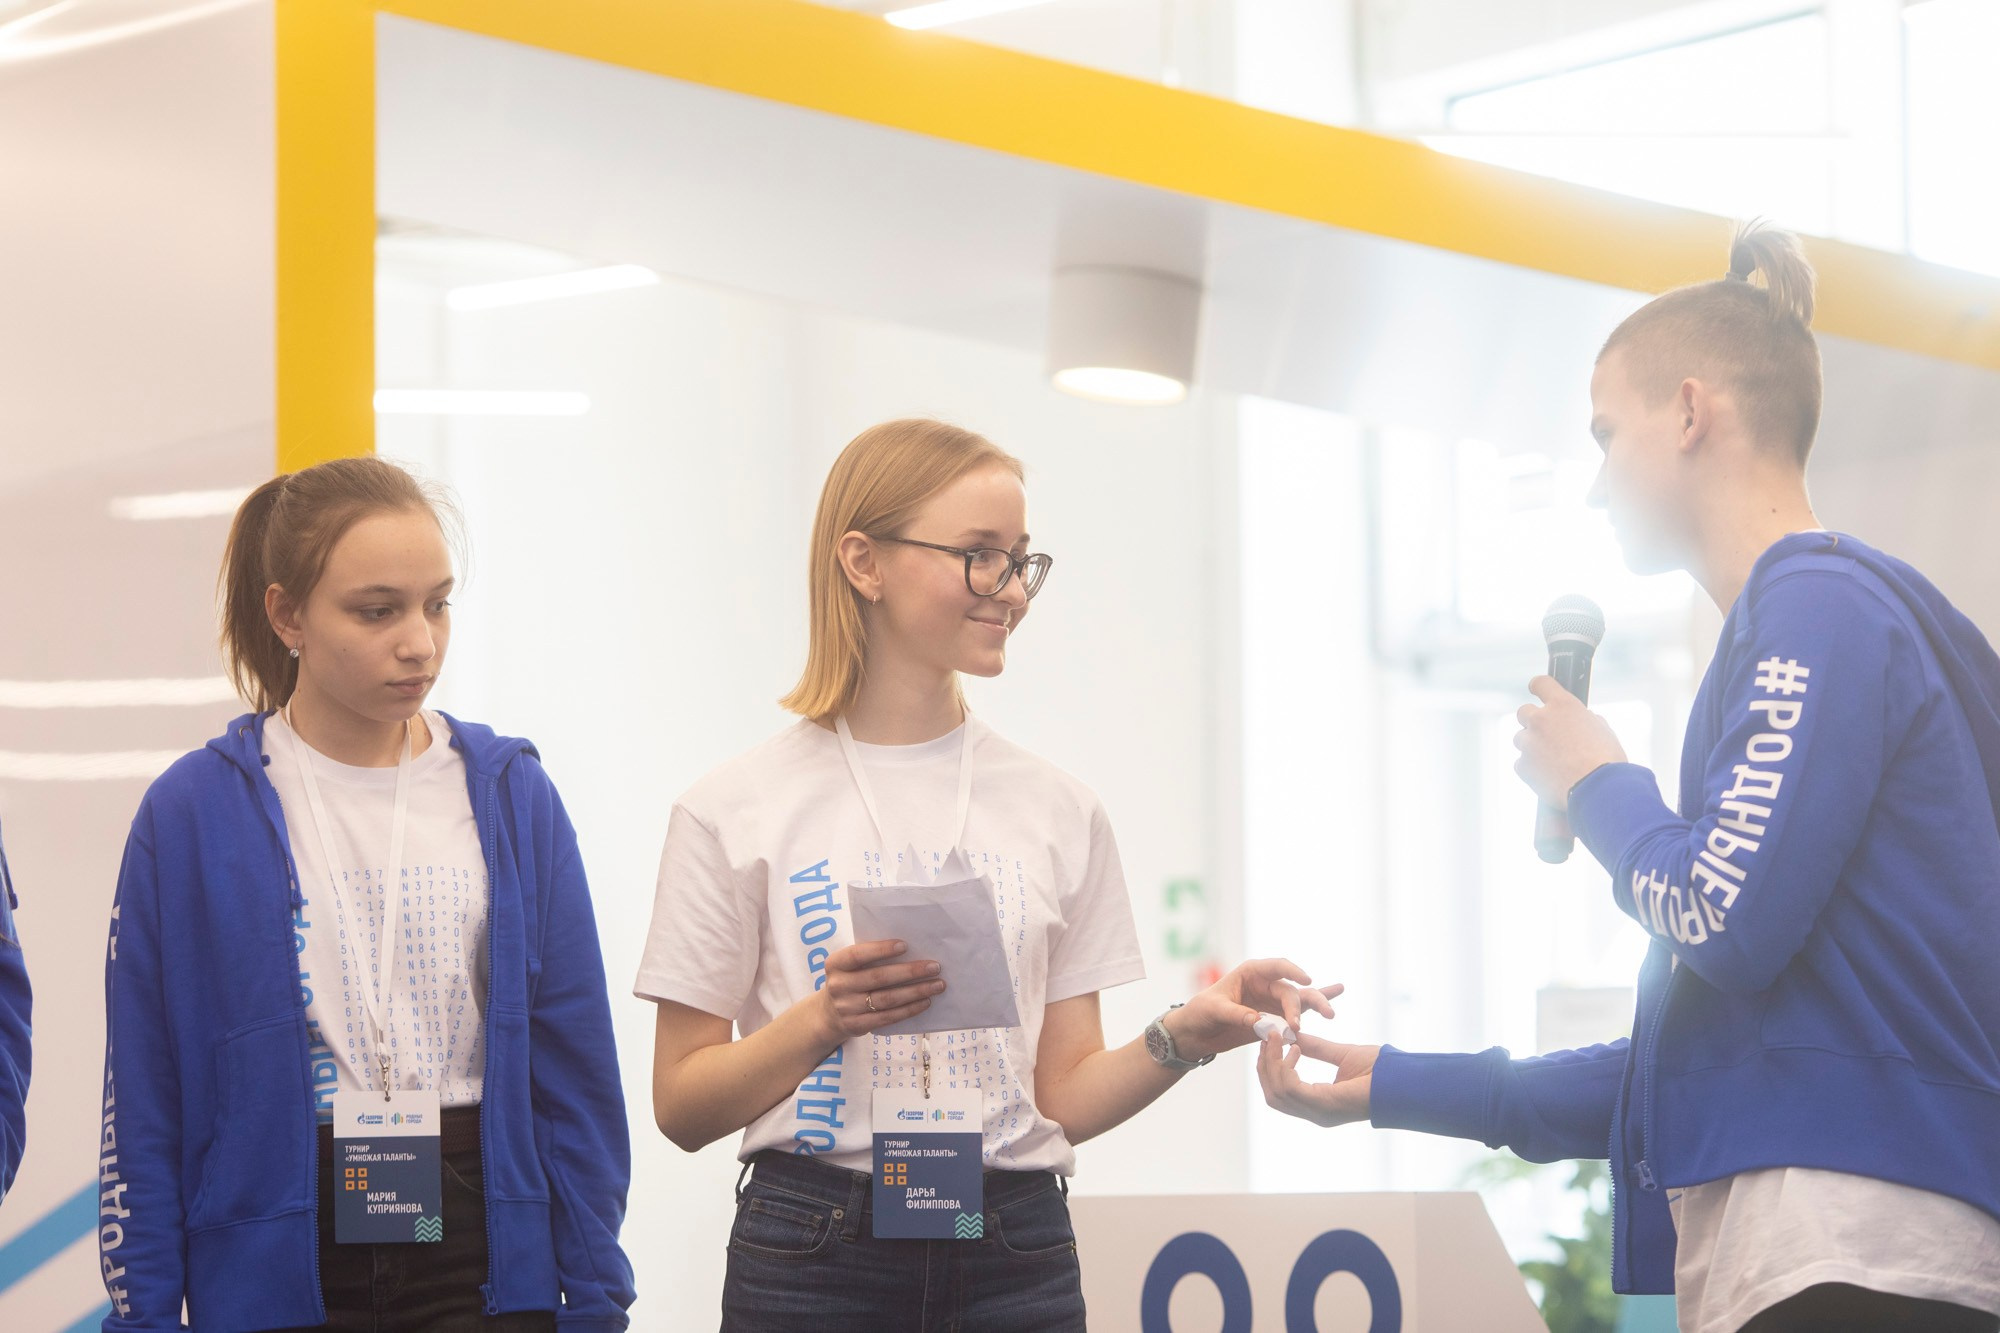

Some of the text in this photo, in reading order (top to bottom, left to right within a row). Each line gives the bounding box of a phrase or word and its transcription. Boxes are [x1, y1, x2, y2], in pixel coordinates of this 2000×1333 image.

[345, 1144, 370, 1154] ТУРНИР
[884, 1140, 910, 1149] ТУРНИР
[345, 1153, 417, 1162] «УМНОЖАЯ ТАЛАНТЫ»
[884, 1149, 958, 1157] «УМНОЖАЯ ТАЛАНТЫ»
[367, 1191, 397, 1202] МАРИЯ
[906, 1187, 936, 1199] ДАРЬЯ
[367, 1203, 423, 1214] КУПРИЯНОВА
[906, 1199, 961, 1210] ФИЛИППОВА
